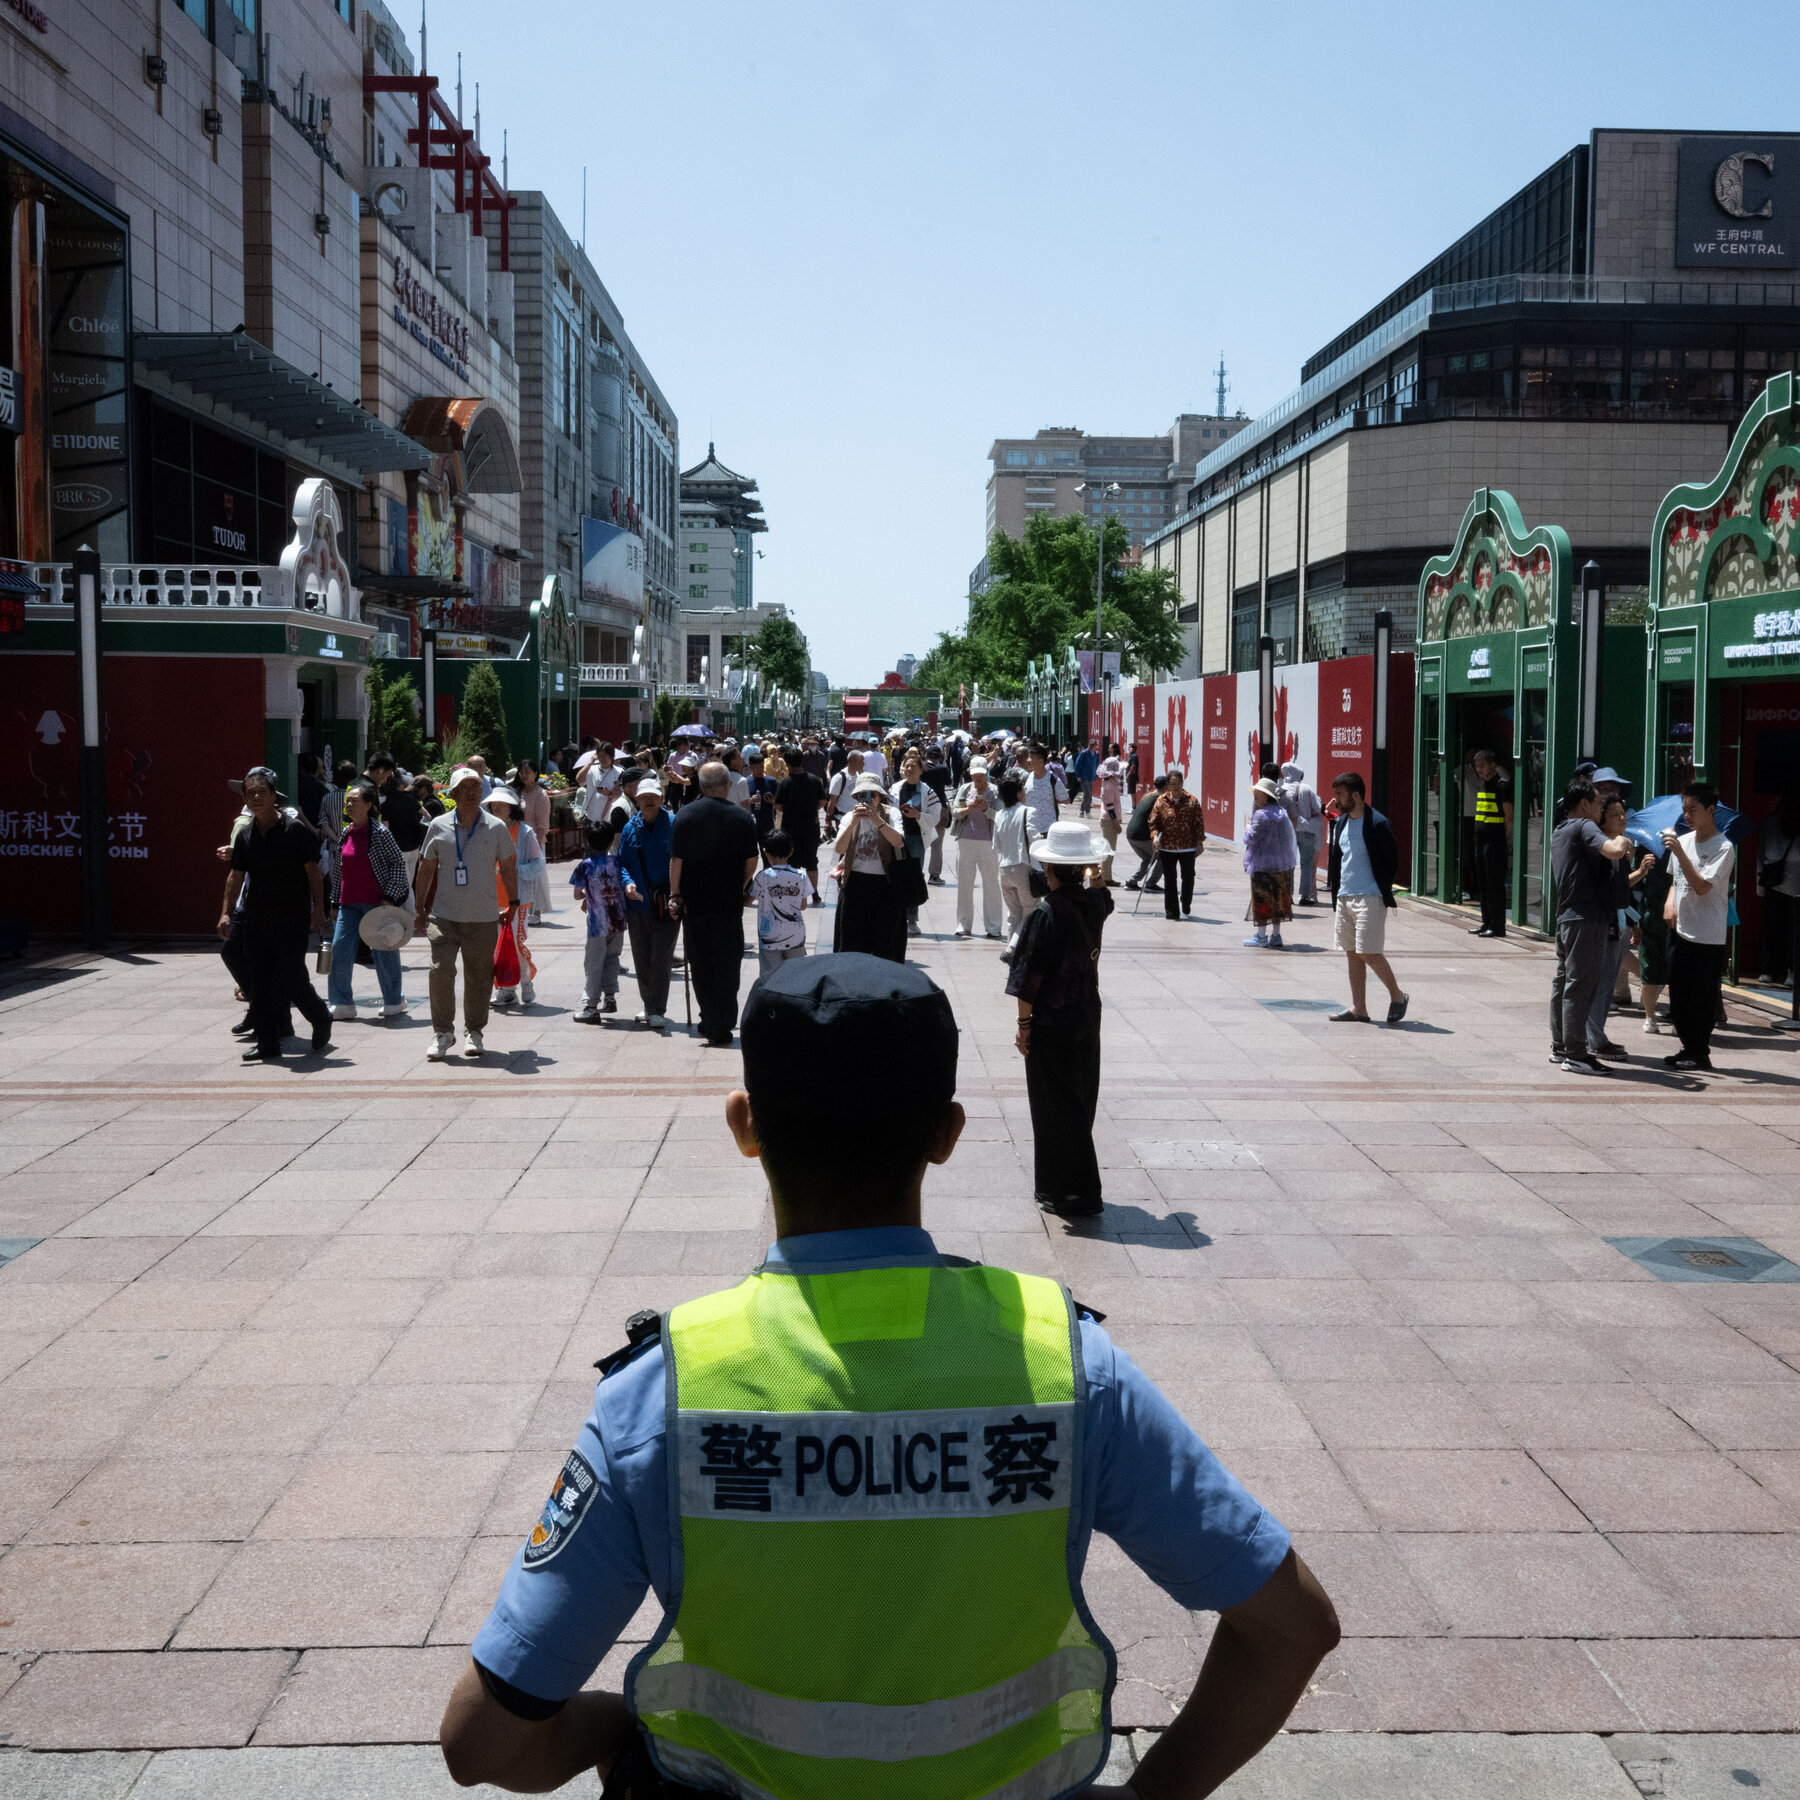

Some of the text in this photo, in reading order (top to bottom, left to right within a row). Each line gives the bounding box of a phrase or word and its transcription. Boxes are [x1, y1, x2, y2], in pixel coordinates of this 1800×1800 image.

[78, 241, 120, 251] GOOSE
[1694, 242, 1785, 255] WF CENTRAL
[52, 372, 106, 386] Margiela
[52, 434, 120, 450] E11DONE
[55, 489, 101, 503] BRIC'S
[212, 525, 247, 552] TUDOR
[699, 1414, 1061, 1513] 警 POLICE 察
